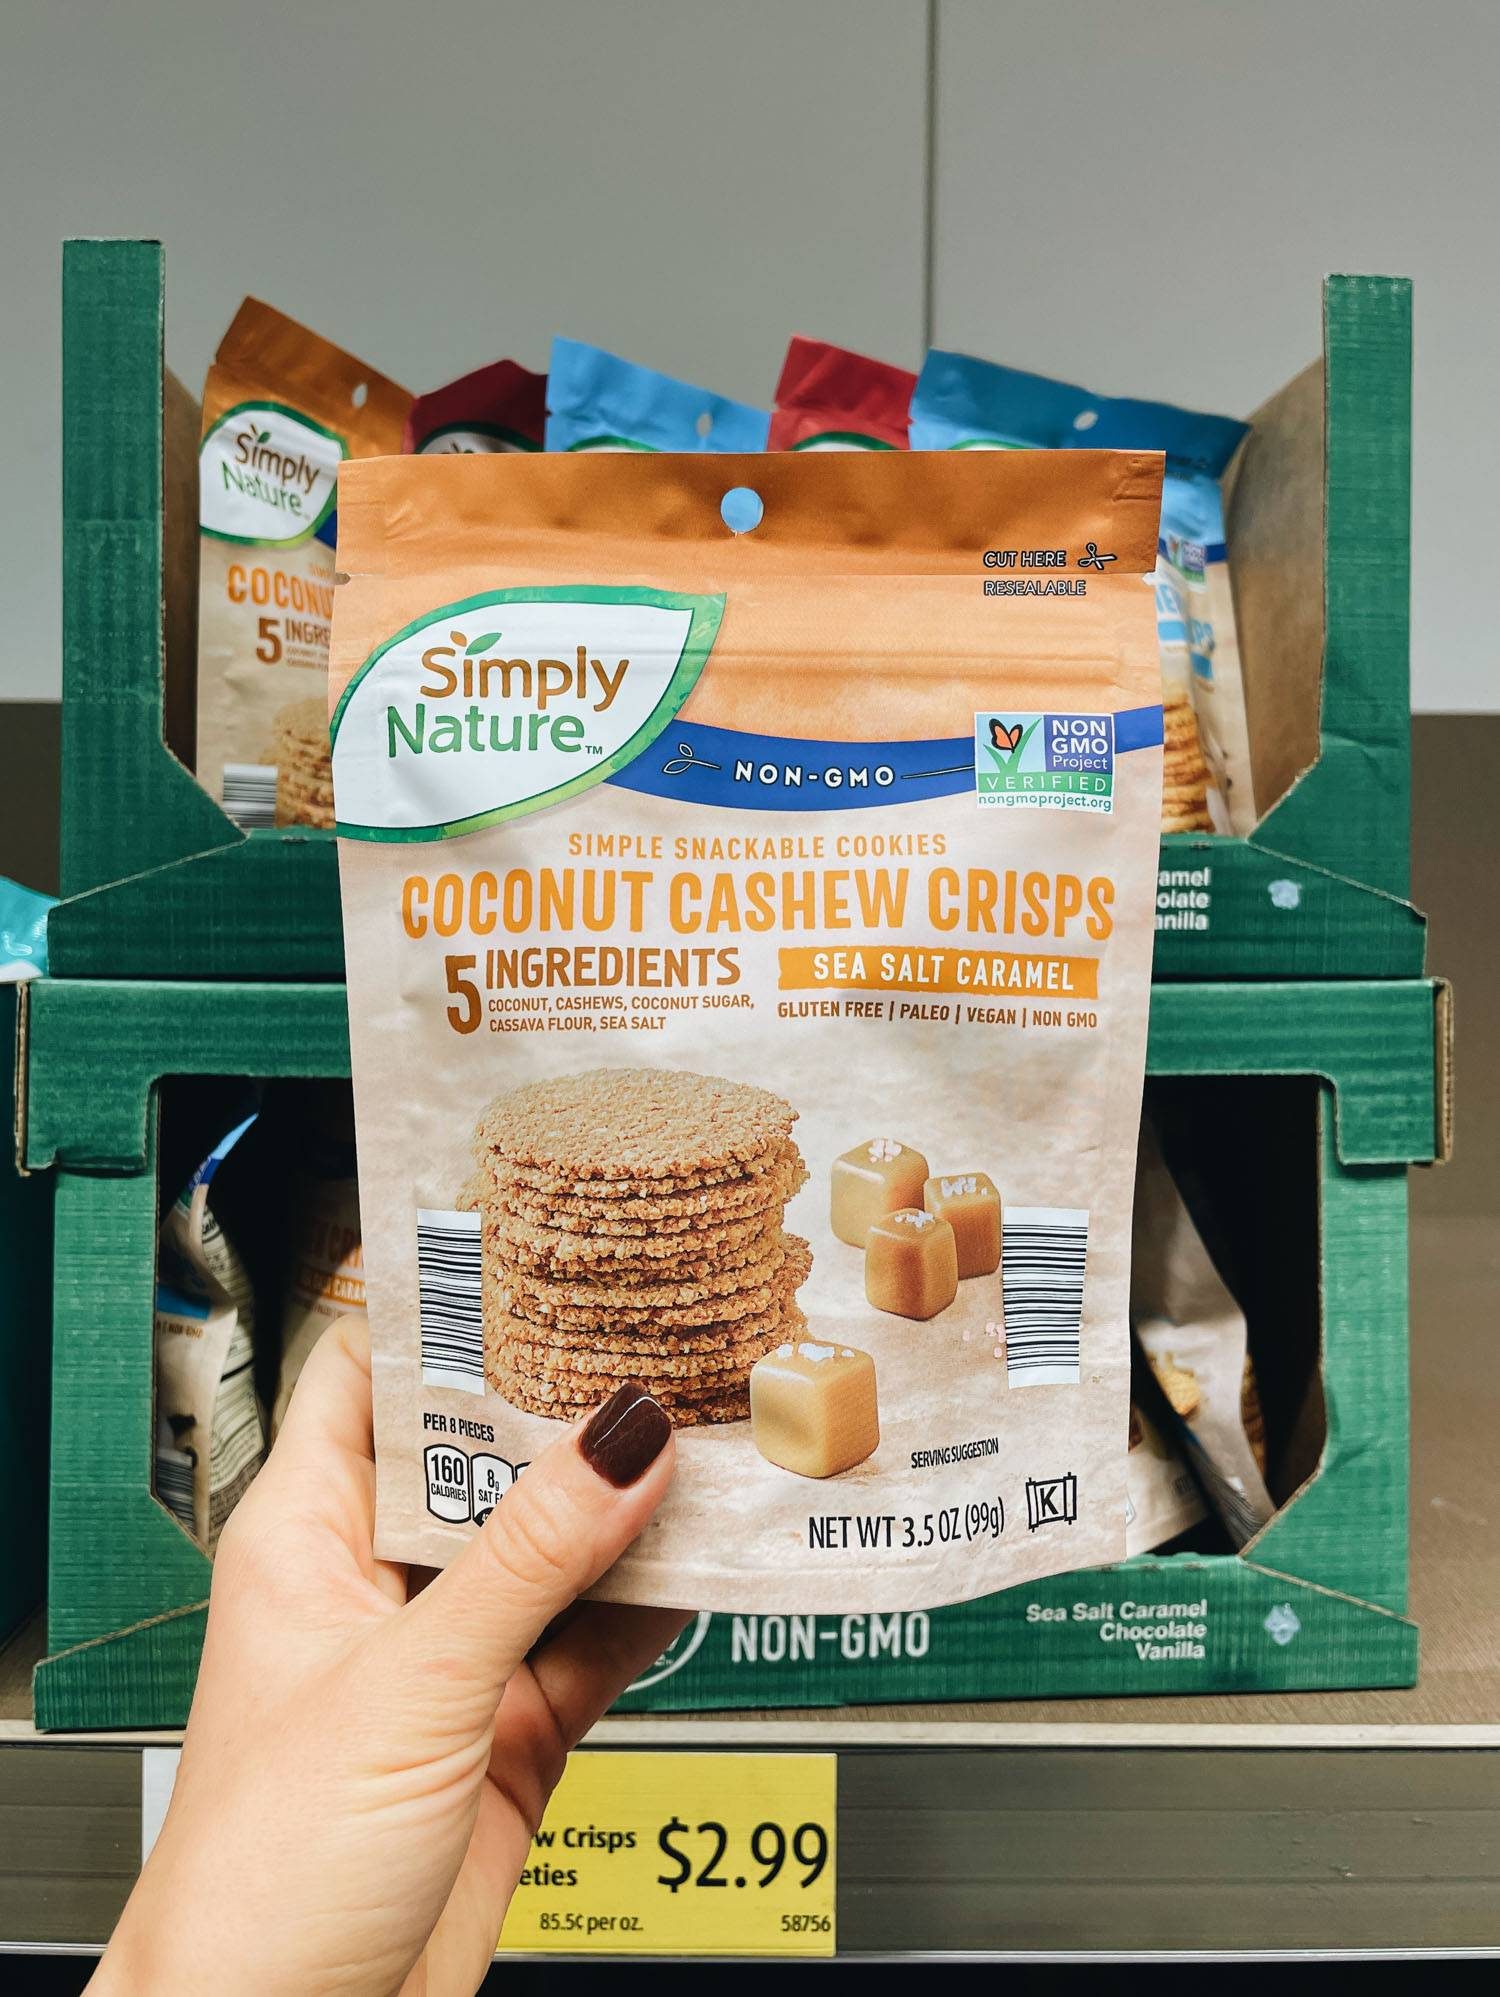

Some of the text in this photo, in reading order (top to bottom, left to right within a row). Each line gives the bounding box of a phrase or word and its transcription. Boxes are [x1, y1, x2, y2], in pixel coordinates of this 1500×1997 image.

[235, 428, 320, 495] Simply
[221, 461, 303, 516] Nature
[984, 551, 1067, 567] CUT HERE
[984, 580, 1086, 595] RESEALABLE
[256, 617, 282, 665] 5
[420, 643, 630, 712] Simply
[387, 703, 585, 758] Nature
[1052, 719, 1107, 737] NON
[1051, 738, 1109, 755] GMO
[734, 760, 895, 788] NON-GMO
[1053, 755, 1108, 771] Project
[986, 776, 1106, 792] VERIFIED
[978, 794, 1112, 812] nongmoproject.org
[568, 832, 947, 860] SIMPLE SNACKABLE COOKIES
[402, 867, 1115, 940] COCONUT CASHEW CRISPS
[814, 952, 1075, 991] SEA SALT CARAMEL
[445, 947, 741, 1035] 5 INGREDIENTS
[488, 994, 755, 1013] COCONUT, CASHEWS, COCONUT SUGAR,
[489, 1016, 667, 1032] CASSAVA FLOUR, SEA SALT
[777, 1001, 1098, 1028] GLUTEN FREE PALEO VEGAN NON GMO
[423, 1412, 495, 1442] PER 8 PIECES
[911, 1437, 999, 1468] SERVING SUGGESTION
[431, 1454, 465, 1486] 160
[430, 1482, 467, 1502] CALORIES
[478, 1488, 493, 1503] SAT
[809, 1496, 1005, 1548] NET WT 3.5 OZ (99g)
[1025, 1598, 1208, 1622] Sea Salt Caramel
[731, 1611, 931, 1663] NON-GMO
[1100, 1621, 1208, 1642] Chocolate
[1135, 1641, 1206, 1661] Vanilla
[563, 1825, 637, 1853] Crisps
[657, 1816, 828, 1893] $2.99
[519, 1863, 578, 1886] eties
[540, 1912, 644, 1934] 85.5¢ per oz.
[781, 1914, 831, 1932] 58756
